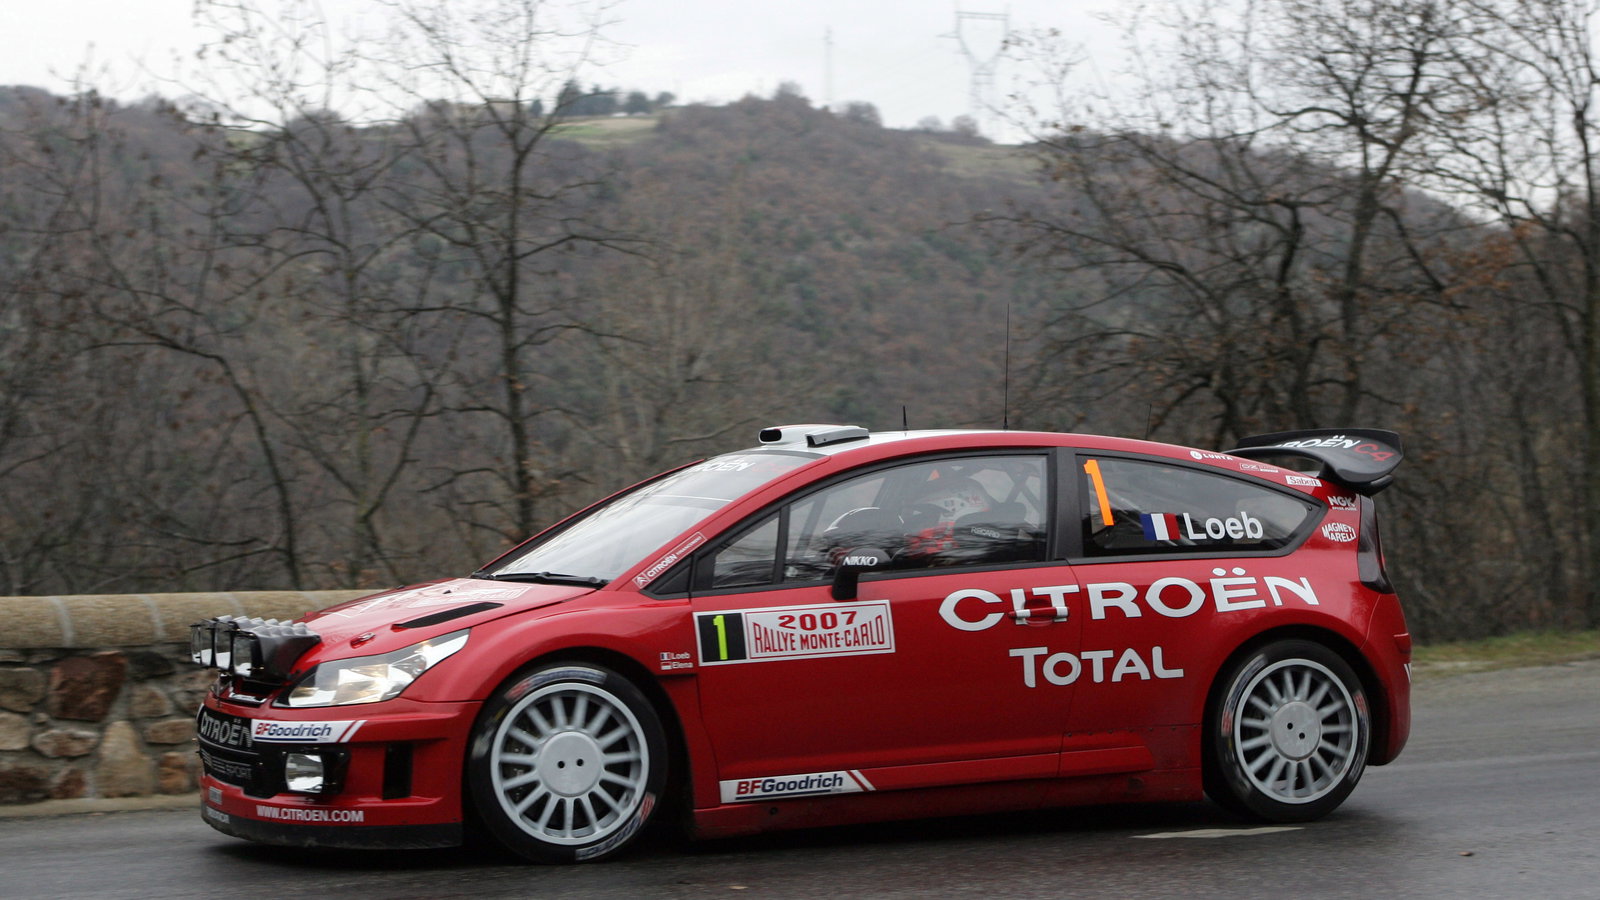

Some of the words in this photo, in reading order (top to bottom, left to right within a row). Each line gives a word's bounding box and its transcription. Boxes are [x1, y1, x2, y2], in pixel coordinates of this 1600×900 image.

[1353, 443, 1395, 462] C4
[1083, 459, 1114, 526] 1
[1327, 495, 1356, 507] NGK
[1183, 511, 1263, 540] Loeb
[843, 555, 878, 566] NIKKO
[939, 566, 1319, 631] CITROËN
[778, 610, 857, 631] 2007
[712, 615, 729, 661] 1
[753, 621, 796, 654] RALLYE
[799, 614, 886, 649] MONTE-CARLO
[672, 652, 690, 660] Loeb
[672, 661, 693, 669] Elena
[201, 711, 252, 748] CITROËN
[254, 722, 331, 737] BFGoodrich
[736, 773, 844, 794] BFGoodrich
[257, 805, 364, 823] WWW.CITROEN.COM
